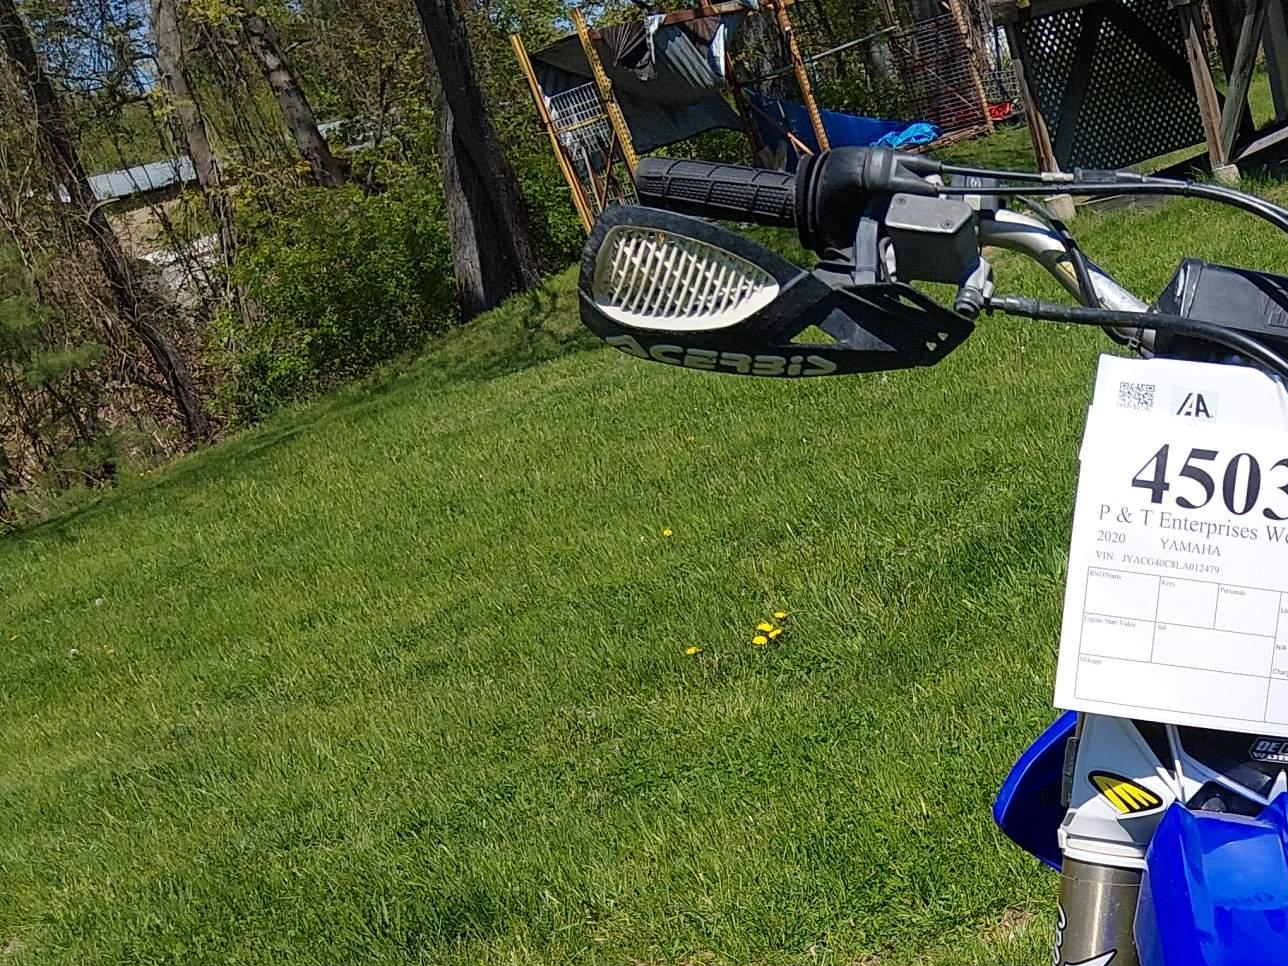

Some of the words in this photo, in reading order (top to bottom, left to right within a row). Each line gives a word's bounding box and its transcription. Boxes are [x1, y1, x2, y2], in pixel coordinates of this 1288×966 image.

[1099, 504, 1111, 520] P
[1116, 506, 1133, 524] &
[1140, 508, 1156, 526] T
[1160, 511, 1258, 540] Enterprises
[1096, 550, 1116, 561] VIN:
[1097, 530, 1126, 544] 2020
[1160, 538, 1221, 557] YAMAHA
